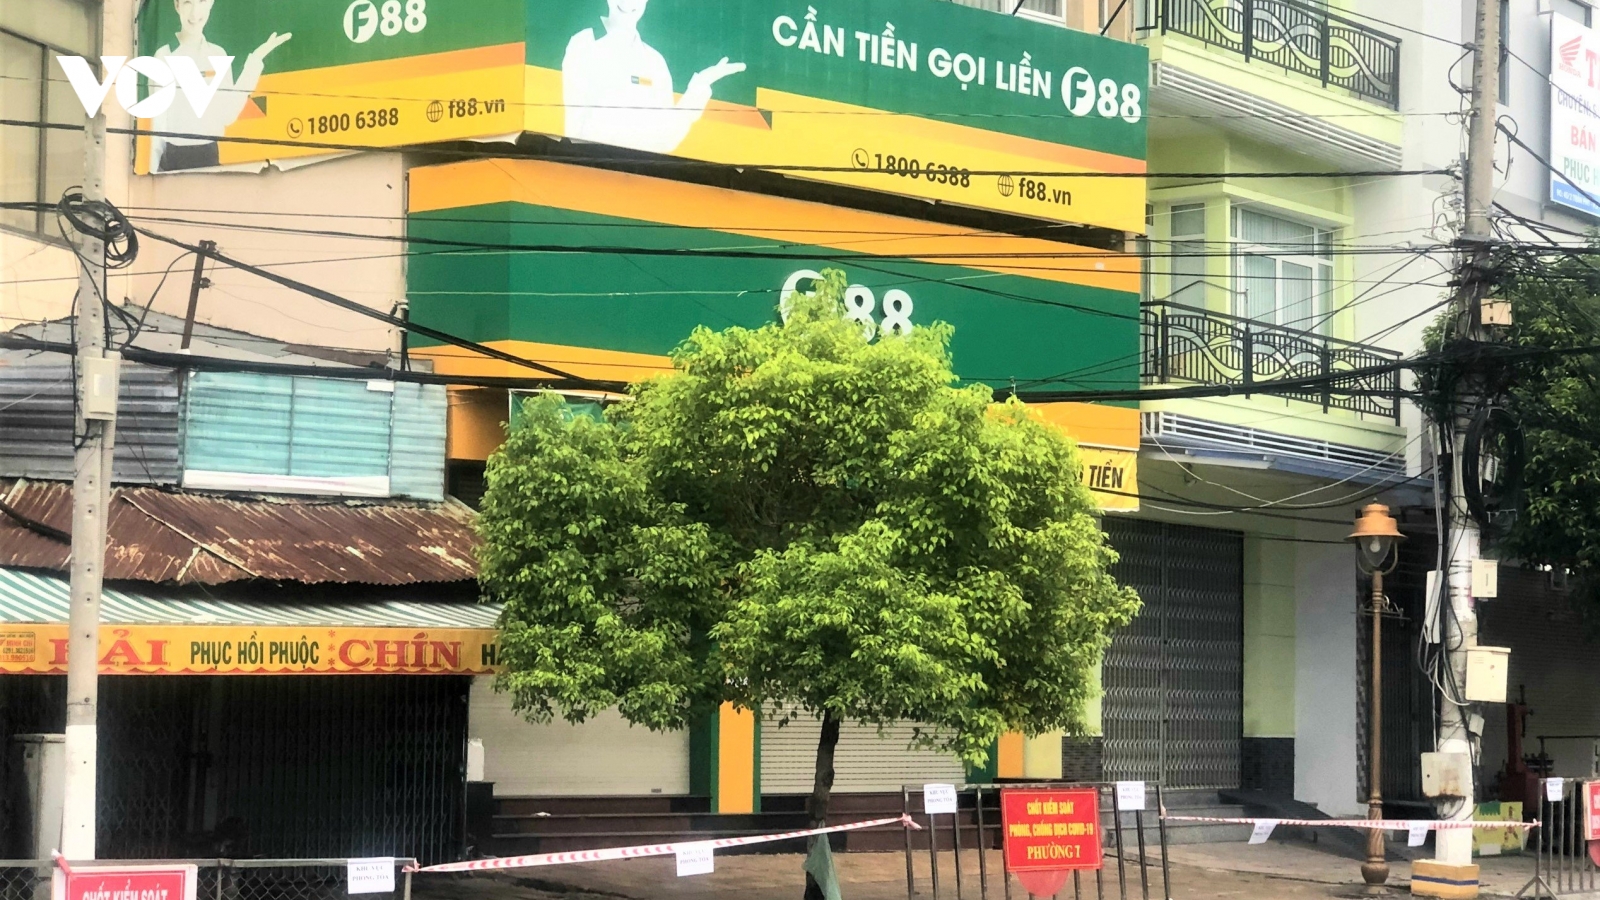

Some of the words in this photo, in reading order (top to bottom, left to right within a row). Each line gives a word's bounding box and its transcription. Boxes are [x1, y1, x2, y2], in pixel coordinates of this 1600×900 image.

[343, 0, 427, 43] F88
[772, 5, 845, 57] CẦN
[855, 21, 918, 72] TIỀN
[927, 47, 986, 91] GỌI
[995, 51, 1052, 99] LIỀN
[1061, 66, 1142, 124] F88
[1558, 62, 1582, 79] HONDA
[307, 113, 350, 135] 1800
[356, 108, 399, 130] 6388
[448, 98, 505, 119] f88.vn
[1570, 124, 1596, 153] BÁN
[874, 153, 920, 179] 1800
[926, 162, 970, 188] 6388
[1563, 156, 1591, 187] PHỤC
[1018, 177, 1072, 206] f88.vn
[1089, 459, 1124, 488] TIỀN
[190, 641, 232, 670] PHỤC
[237, 631, 264, 665] HỒI
[269, 635, 320, 670] PHUỘC
[338, 632, 462, 668] CHÍN
[1027, 841, 1074, 860] PHƯỜNG
